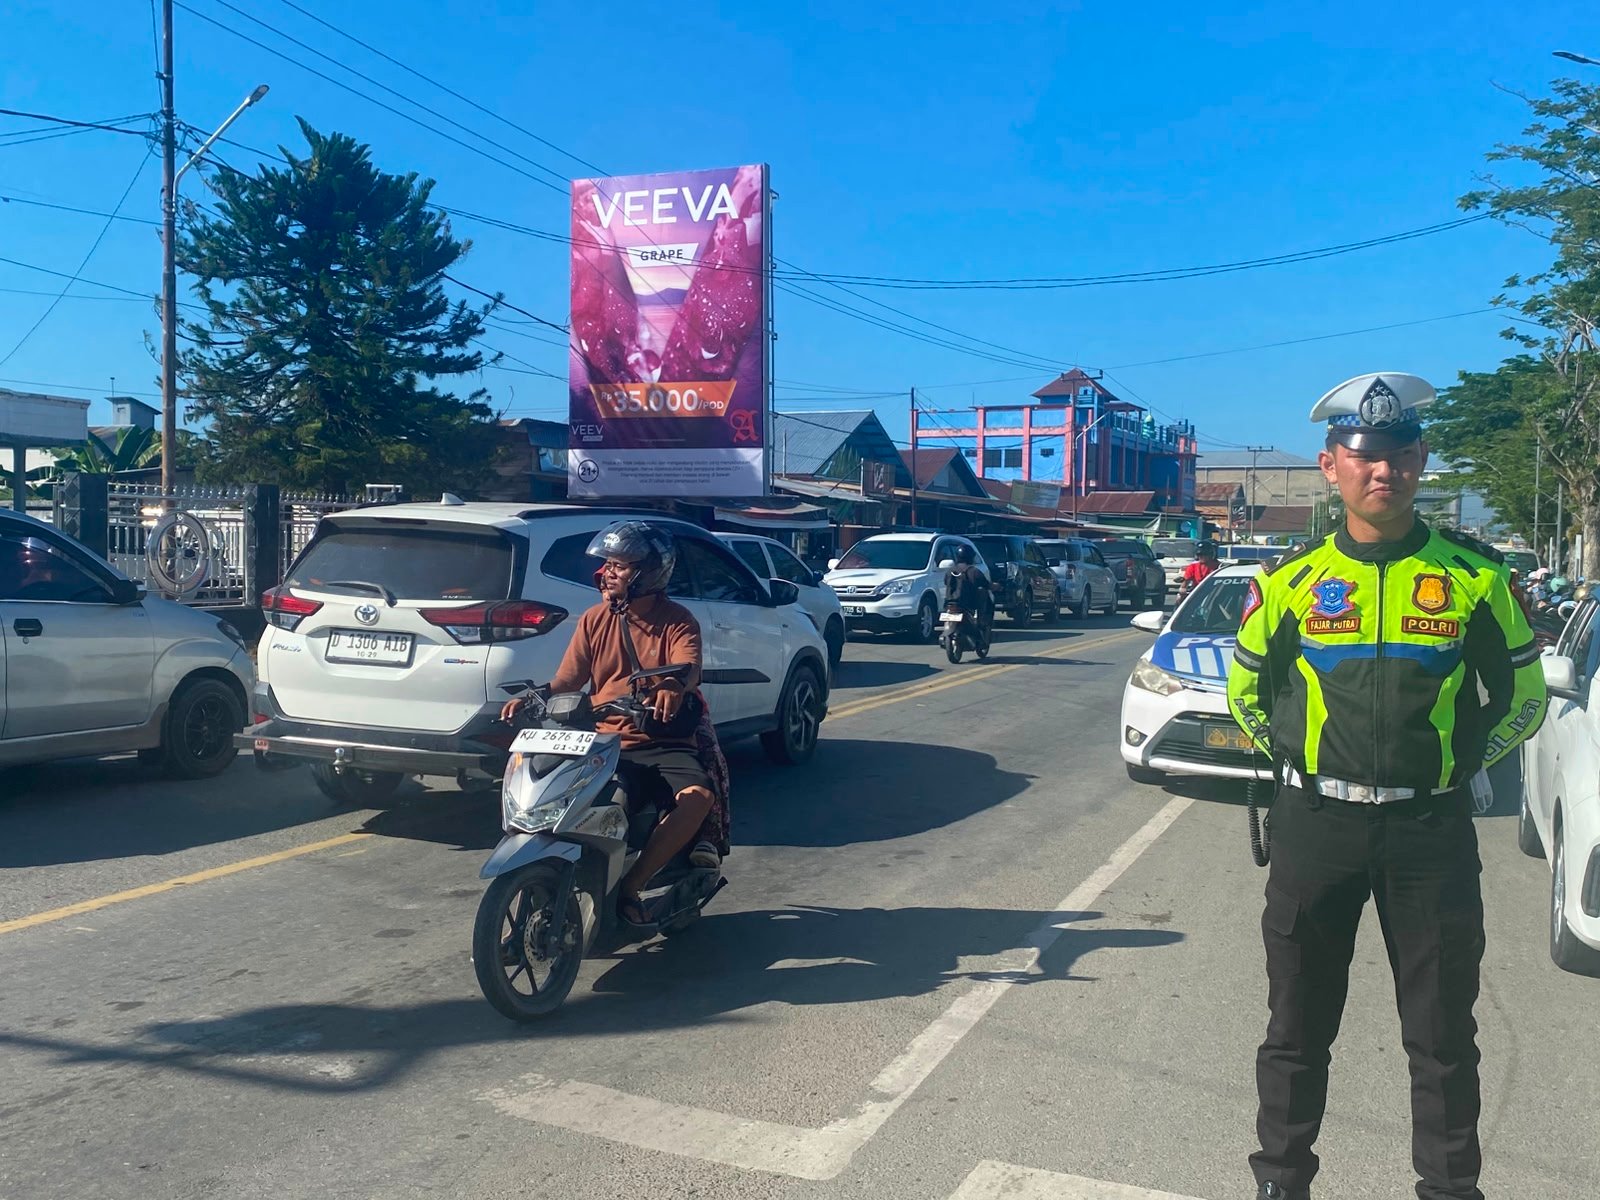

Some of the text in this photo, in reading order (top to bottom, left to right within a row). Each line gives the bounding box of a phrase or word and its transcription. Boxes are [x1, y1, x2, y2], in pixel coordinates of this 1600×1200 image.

[592, 183, 739, 229] VEEVA
[640, 249, 683, 261] GRAPE
[571, 424, 604, 436] VEEV
[580, 466, 597, 476] 21+
[1310, 619, 1355, 630] FAJAR PUTRA
[1407, 619, 1453, 633] POLRI
[331, 633, 339, 648] D
[384, 636, 408, 652] AIB
